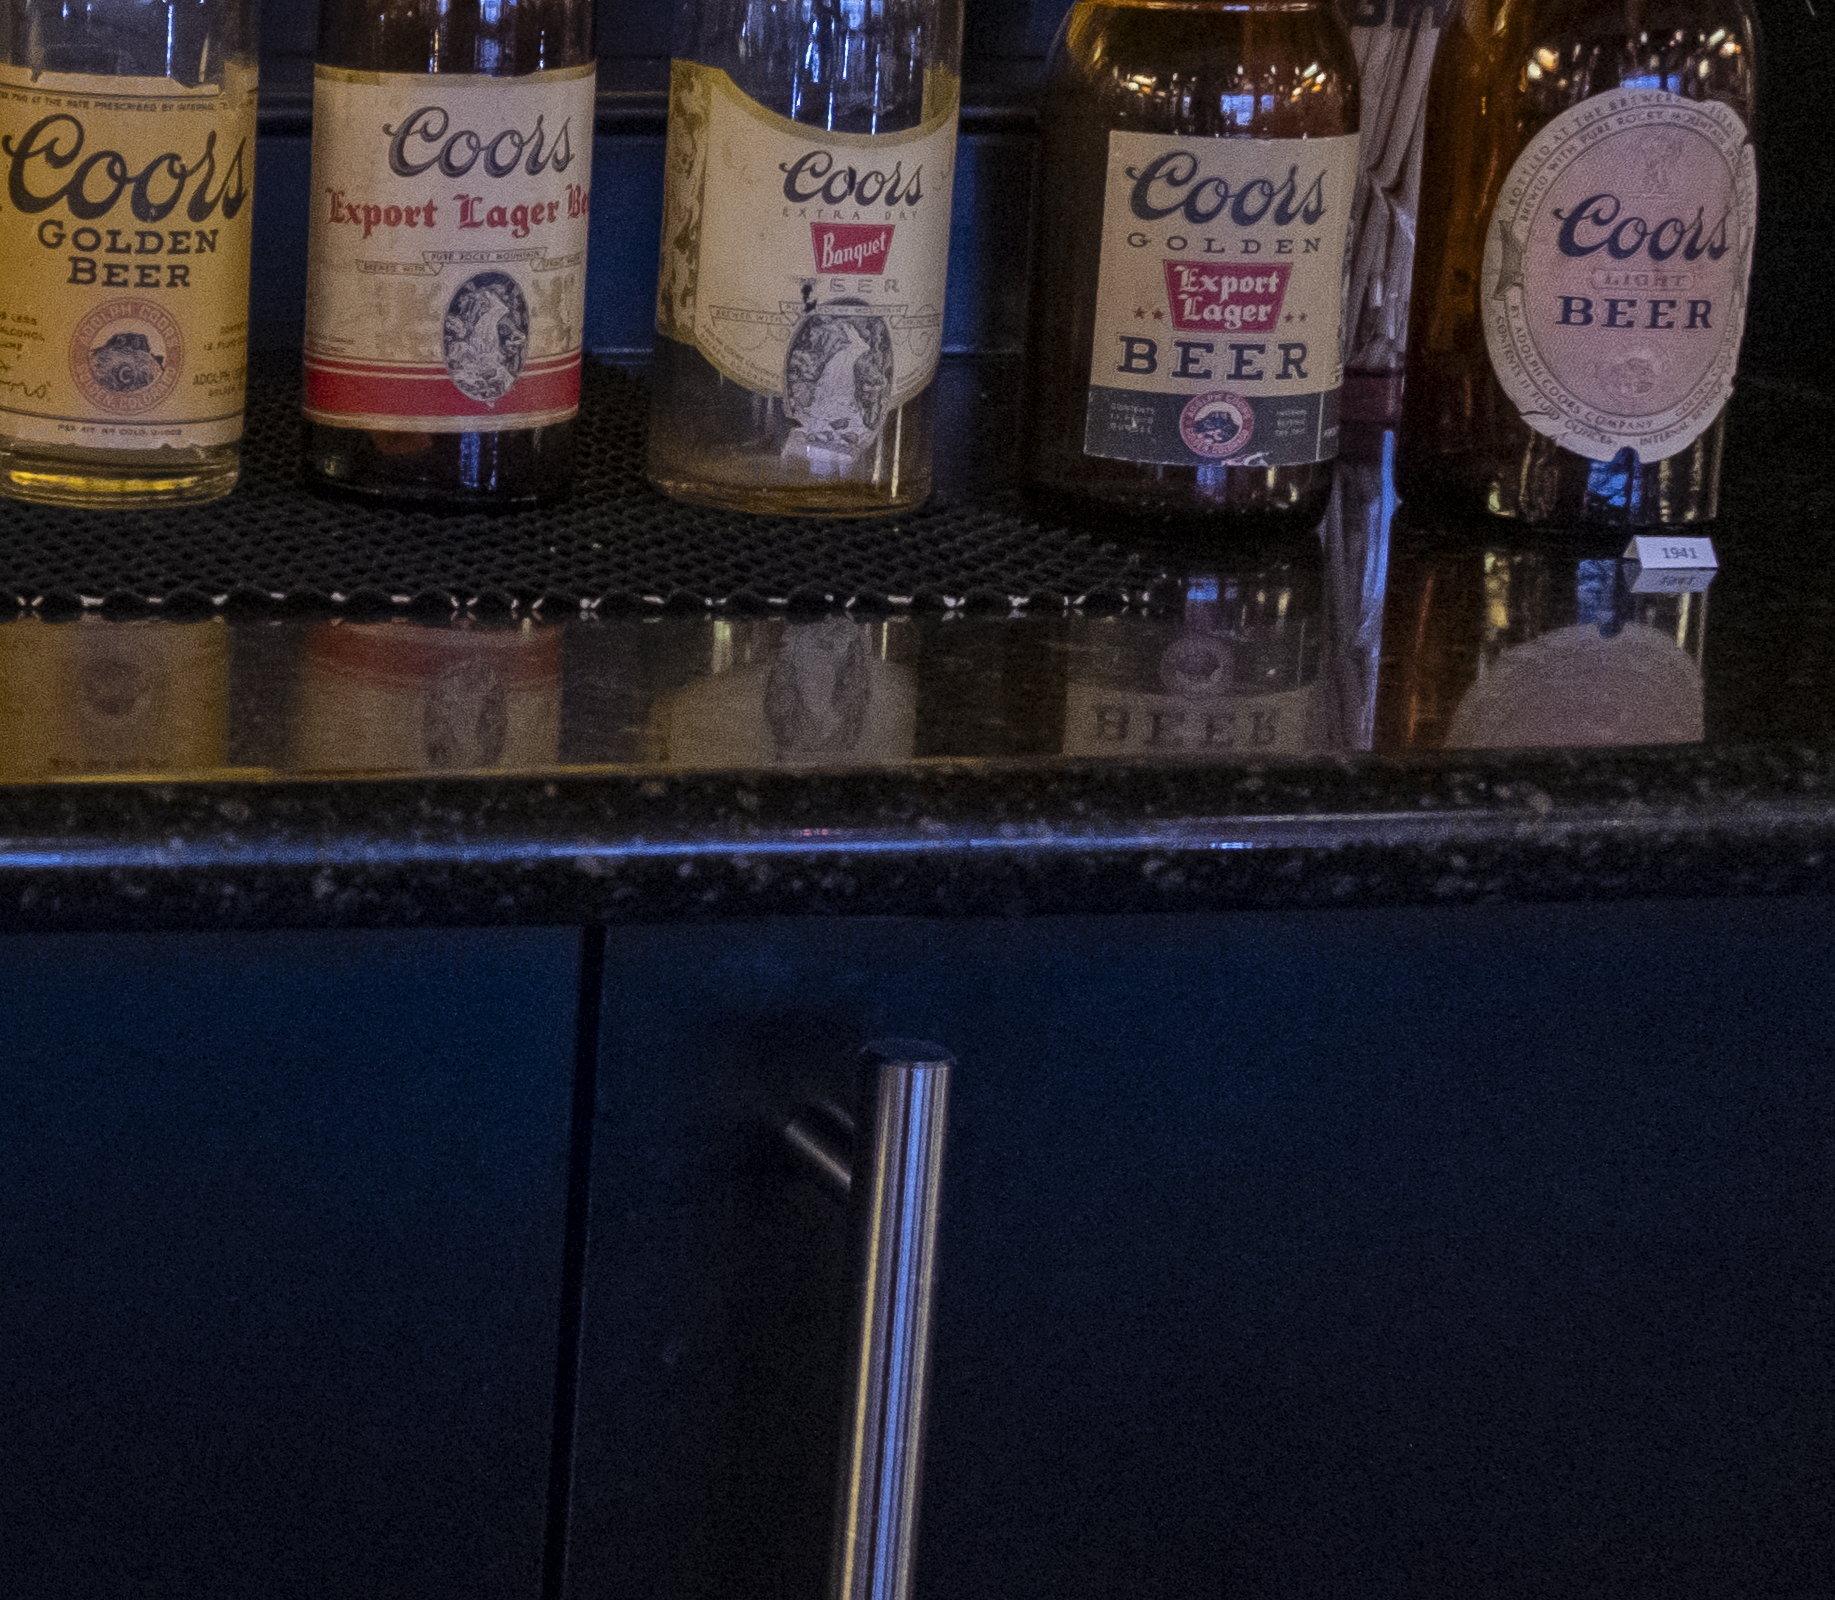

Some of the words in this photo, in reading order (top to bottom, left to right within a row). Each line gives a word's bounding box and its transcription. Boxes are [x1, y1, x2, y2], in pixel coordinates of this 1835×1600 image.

[382, 105, 576, 178] Coors
[1549, 144, 1578, 173] WITH
[1580, 121, 1612, 146] PURE
[1616, 110, 1664, 127] ROCKY
[1552, 125, 1570, 143] AT
[1572, 104, 1603, 128] THE
[2, 113, 249, 224] Coors
[779, 150, 925, 208] Coors
[1125, 151, 1328, 227] Coors
[326, 186, 439, 239] Export
[453, 193, 561, 239] Lager
[782, 206, 861, 221] EXTRA
[883, 208, 919, 222] DRY
[1551, 191, 1731, 261] Coors
[37, 220, 220, 256] GOLDEN
[821, 231, 888, 270] Banquet
[1127, 232, 1322, 255] GOLDEN
[66, 256, 192, 289] BEER
[829, 277, 901, 294] EER
[1174, 263, 1280, 304] Export
[1604, 273, 1688, 288] LIGHT
[77, 303, 133, 348] ADOLPH
[138, 304, 181, 350] COORS
[1179, 294, 1273, 330] Lager
[1555, 295, 1714, 330] BEER
[1116, 334, 1309, 381] BEER
[1515, 325, 1543, 378] ADOLPH
[1542, 378, 1581, 416] COORS
[1584, 410, 1654, 431] COMPANY
[118, 365, 177, 411] COLORADO
[1661, 546, 1700, 560] 1941
